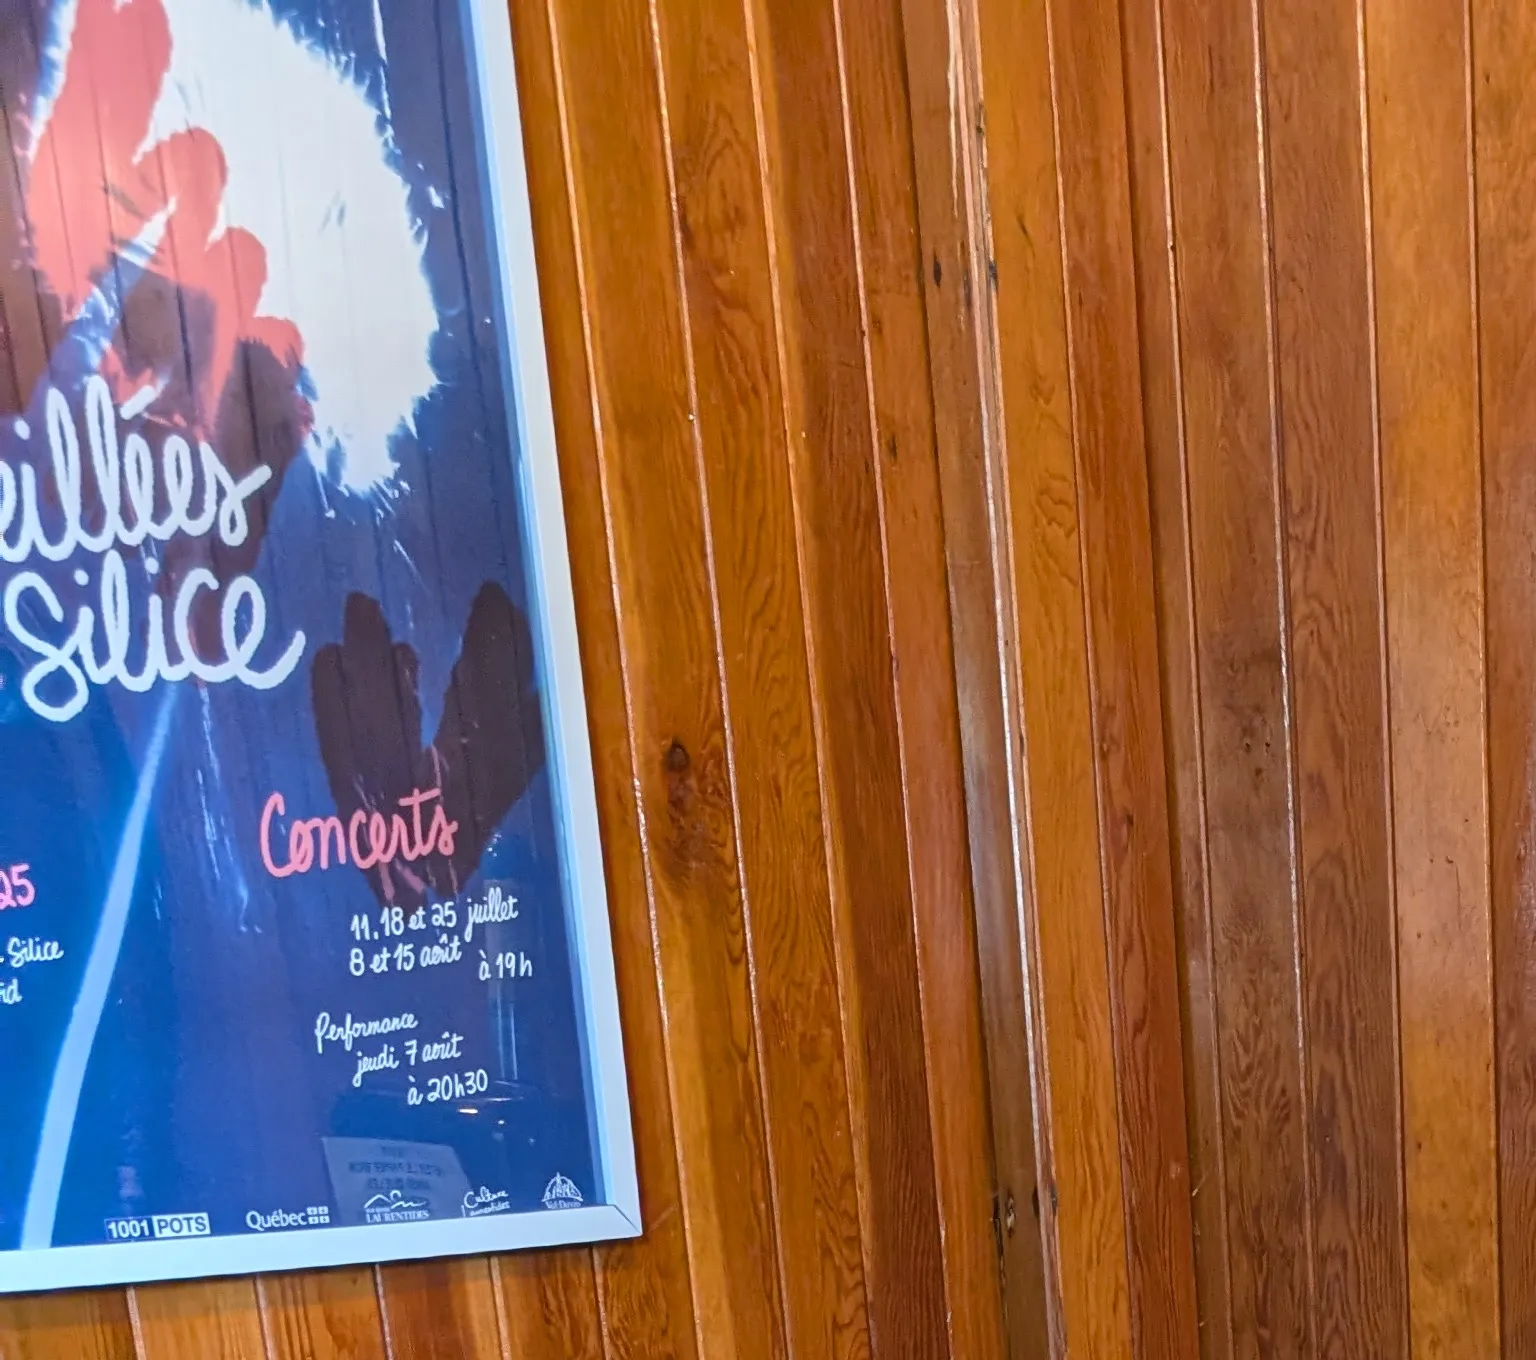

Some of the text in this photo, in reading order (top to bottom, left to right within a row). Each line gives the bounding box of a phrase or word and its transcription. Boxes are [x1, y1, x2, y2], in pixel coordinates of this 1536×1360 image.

[4, 549, 306, 722] Silice
[260, 787, 459, 878] Concerts
[408, 905, 427, 931] et
[431, 901, 457, 928] 25
[464, 886, 519, 943] juillet
[350, 932, 463, 976] 8 et 15 août
[478, 949, 492, 981] à
[314, 1011, 419, 1054] Performance
[352, 1031, 464, 1088] jeudi 7 août
[407, 1068, 489, 1106] à 20h30
[107, 1215, 208, 1239] 1001 POTS
[246, 1208, 308, 1232] Québec
